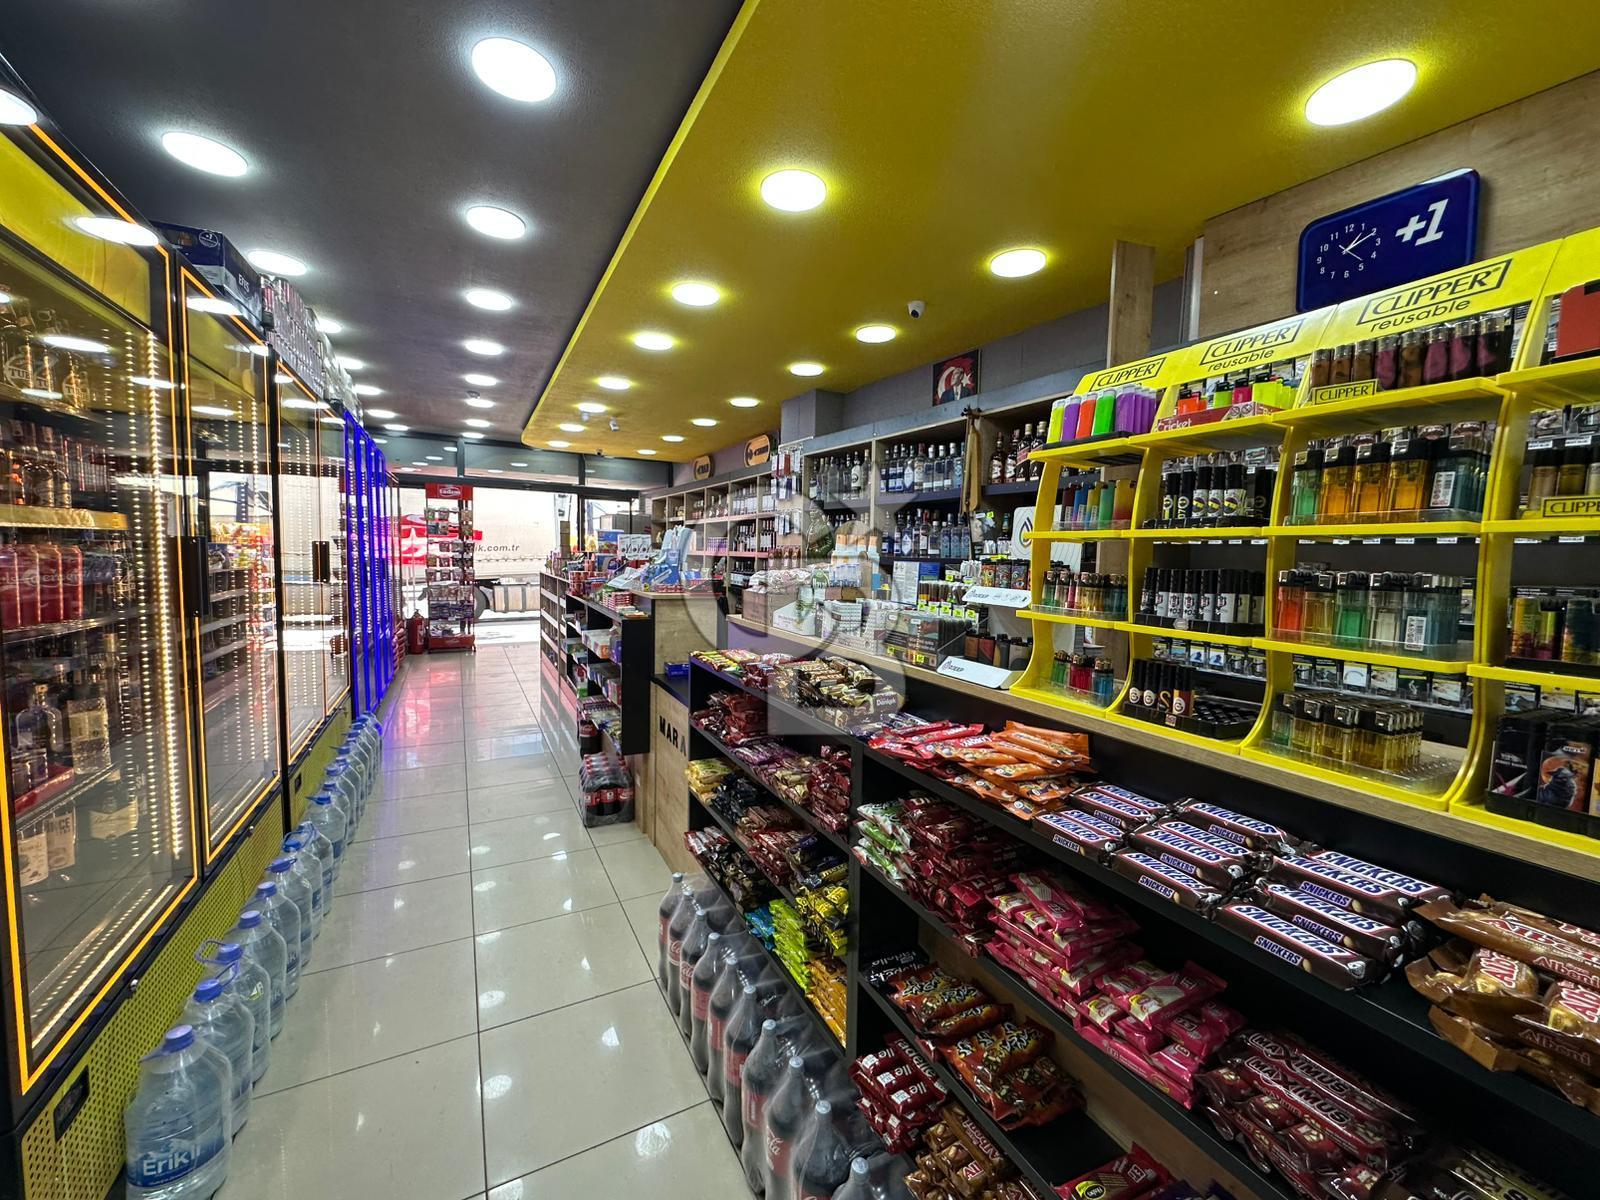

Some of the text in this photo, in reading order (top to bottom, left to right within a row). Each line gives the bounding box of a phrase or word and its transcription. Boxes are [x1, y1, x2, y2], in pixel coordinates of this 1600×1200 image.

[1345, 223, 1355, 233] 12
[1361, 223, 1366, 231] 1
[1395, 199, 1449, 247] +1
[1320, 244, 1329, 252] 10
[1330, 232, 1339, 241] 11
[1375, 238, 1381, 246] 3
[1316, 256, 1322, 264] 9
[1358, 263, 1364, 271] 5
[1371, 251, 1377, 259] 4
[1330, 271, 1335, 279] 7
[1343, 270, 1350, 278] 6
[1371, 271, 1492, 316] CLIPPER
[1370, 300, 1472, 333] reusable
[1210, 330, 1290, 358] CLIPPER
[1208, 349, 1275, 373] reusable
[1097, 364, 1157, 390] CLIPPER
[1319, 386, 1370, 402] CLIPPER
[1156, 418, 1193, 432] Cricket
[1087, 792, 1144, 817] SNICKERS
[1103, 785, 1162, 809] SNICKERS
[1044, 814, 1101, 842] SNICKERS
[1066, 810, 1122, 836] SNICKERS
[1095, 810, 1121, 827] SNICKERS
[1192, 802, 1284, 837] SNICKERS
[1054, 834, 1080, 852] SNICKERS
[1170, 822, 1247, 857] SNICKERS
[1210, 825, 1245, 844] SNICKERS
[1149, 831, 1224, 863] SNICKERS
[1131, 853, 1205, 891] SNICKERS
[1162, 853, 1195, 874] SNICKERS
[1283, 854, 1390, 895] SNICKERS
[1323, 851, 1430, 894] SNICKERS
[1140, 876, 1173, 898] SNICKERS
[1302, 882, 1350, 906] SNICKERS
[1272, 884, 1383, 931] SNICKERS
[1238, 906, 1342, 955] SNICKERS
[1294, 916, 1342, 942] SNICKERS
[1256, 936, 1300, 965] SNICKERS
[1253, 1033, 1352, 1096] MAXIMUS
[1249, 1059, 1350, 1126] MAXIMUS
